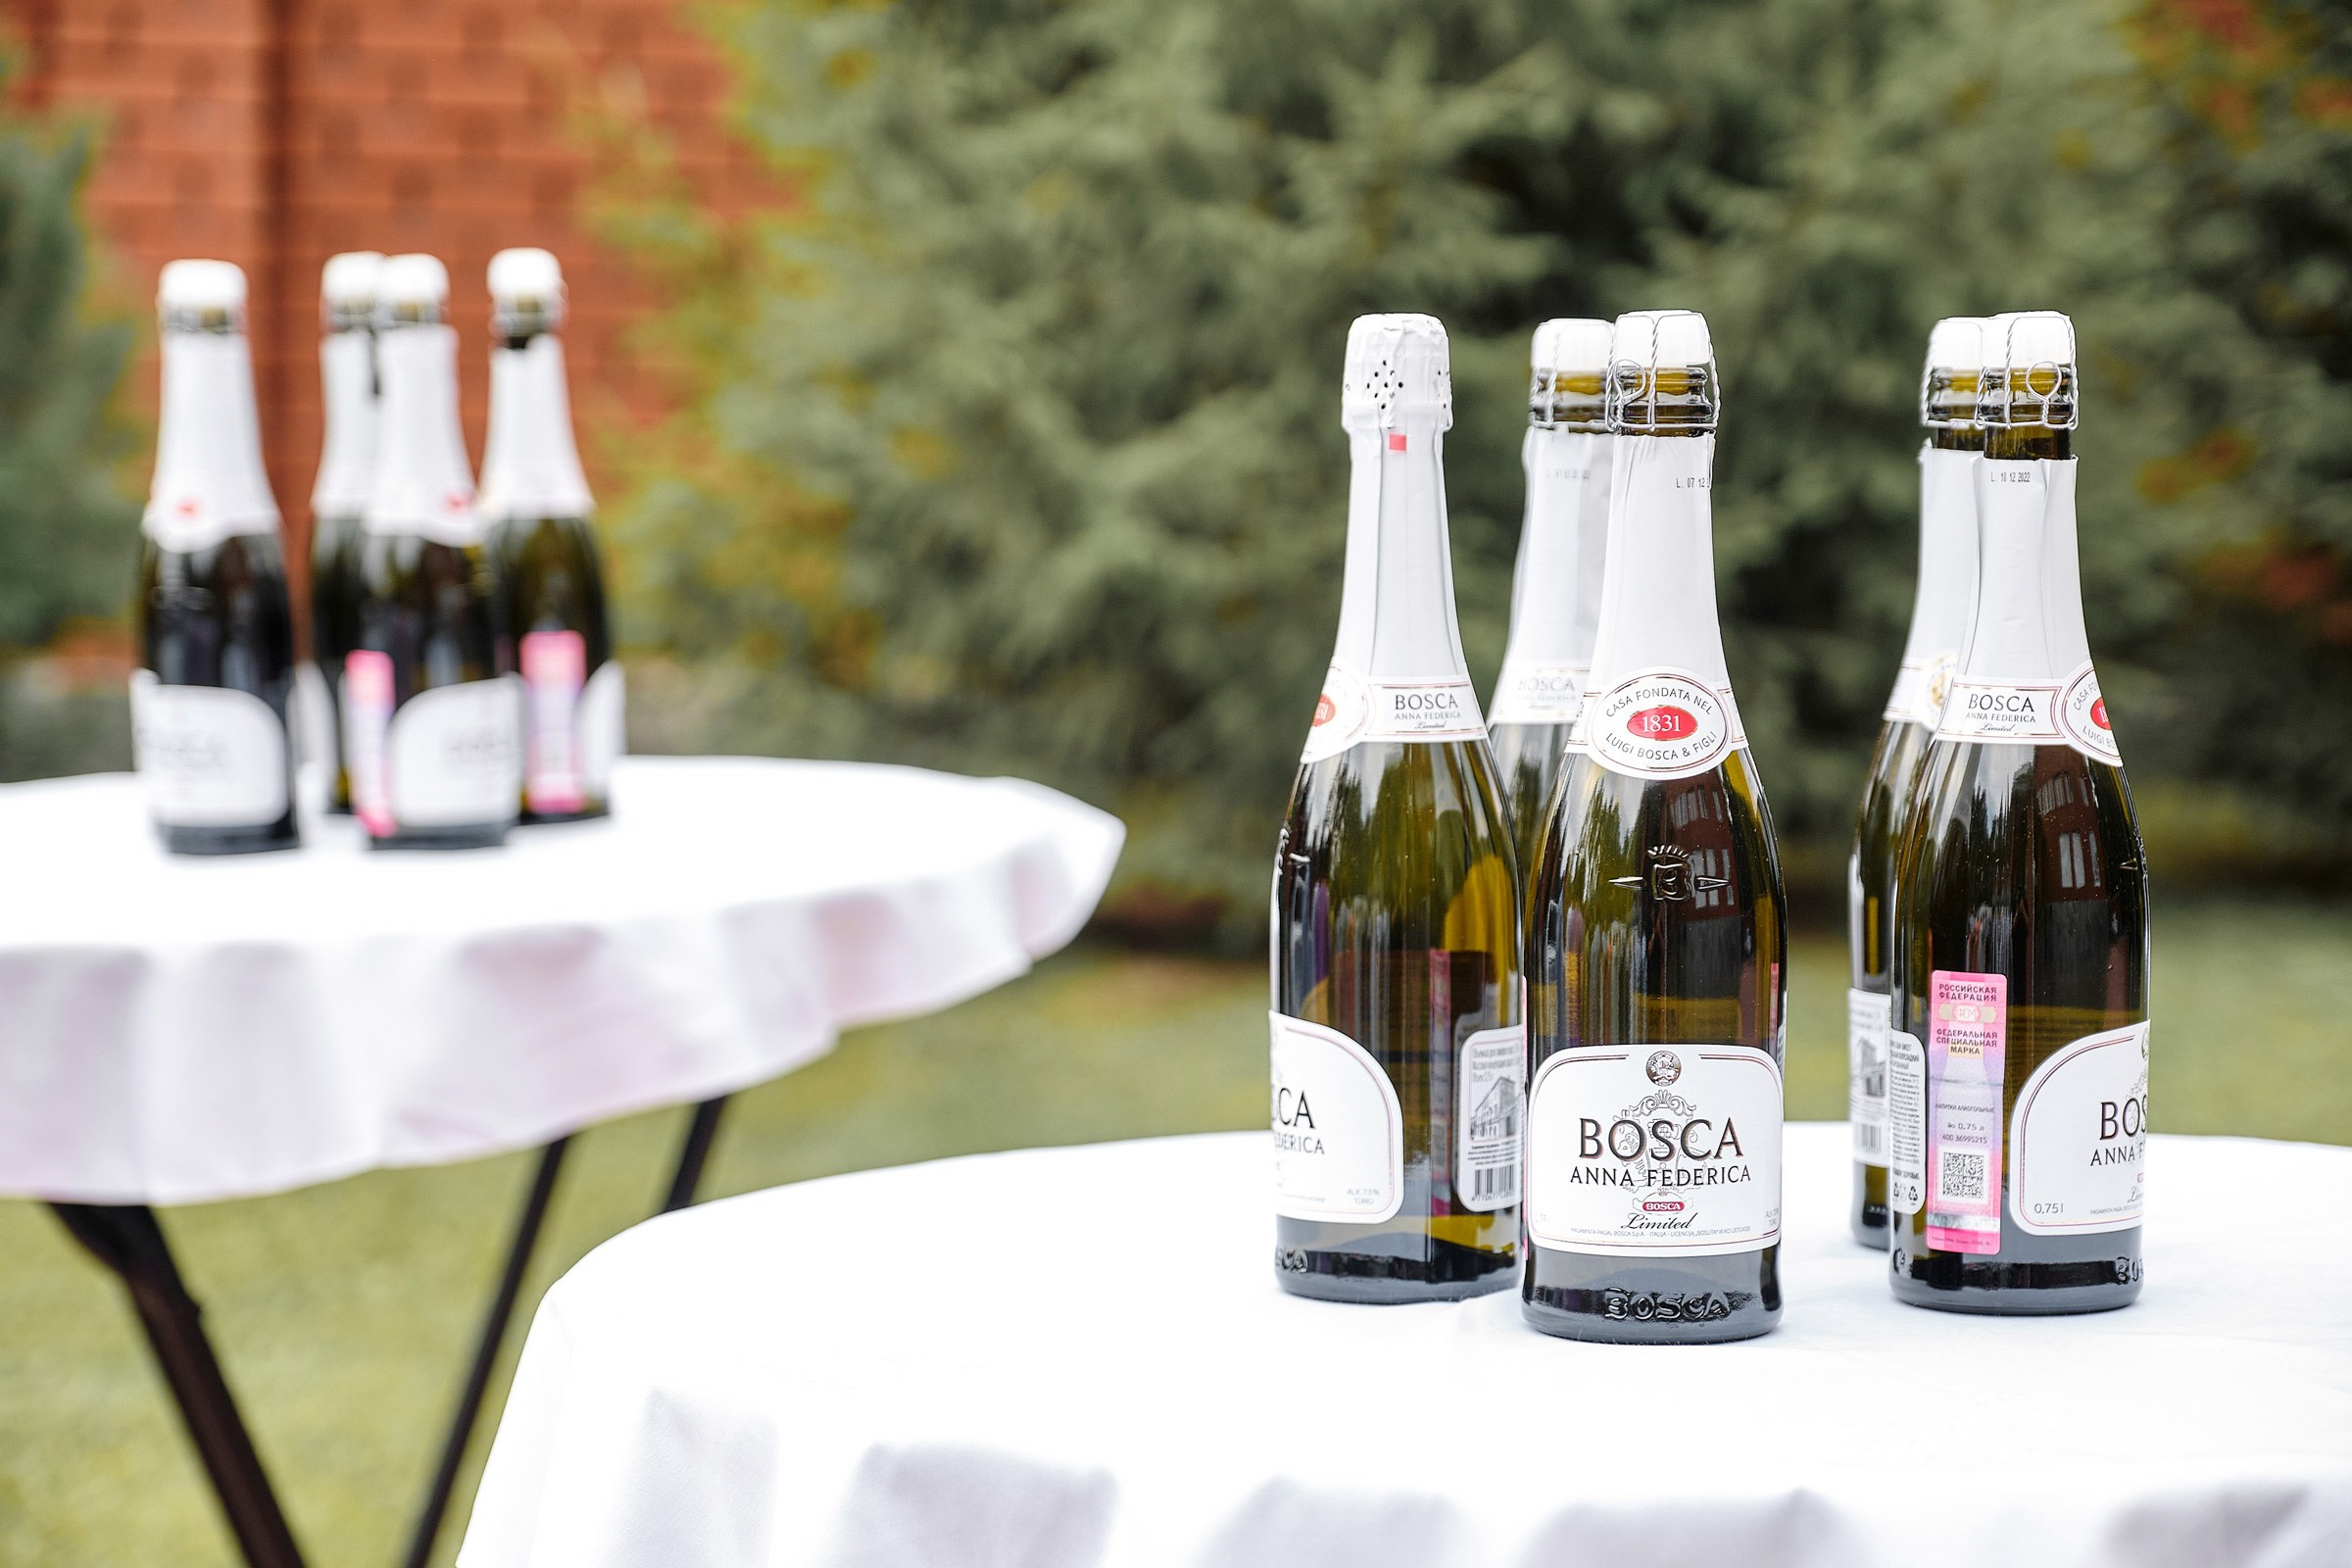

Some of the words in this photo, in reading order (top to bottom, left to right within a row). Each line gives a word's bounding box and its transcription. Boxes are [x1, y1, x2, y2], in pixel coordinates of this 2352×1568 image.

[1687, 477, 1695, 488] 07
[1395, 693, 1459, 710] BOSCA
[1605, 696, 1633, 717] CASA
[1636, 687, 1691, 701] FONDATA
[1694, 695, 1713, 714] NEL
[1968, 693, 2035, 712] BOSCA
[2074, 688, 2090, 710] CASA
[1395, 711, 1422, 720] ANNA
[1424, 710, 1462, 720] FEDERICA
[1642, 714, 1681, 732] 1831
[1965, 711, 1988, 720] ANNA
[1990, 713, 2036, 723] FEDERICA
[2082, 725, 2105, 746] LUIGI
[1605, 732, 1634, 755] LUIGI
[1638, 747, 1679, 760] BOSCA
[1682, 747, 1691, 758] &
[1693, 731, 1717, 754] FIGLI
[1938, 983, 1997, 994] РОССИЙСКАЯ
[1938, 992, 1997, 1002] ФЕДЕРАЦИЯ
[1936, 1028, 1997, 1039] ФЕДЕРАЛЬНАЯ
[1936, 1036, 1997, 1048] СПЕЦИАЛЬНАЯ
[1950, 1046, 1981, 1054] МАРКА
[1579, 1117, 1744, 1161] BOSCA
[2090, 1145, 2135, 1166] ANNA
[1570, 1166, 1635, 1186] ANNA
[1647, 1164, 1751, 1187] FEDERICA
[1645, 1201, 1682, 1211] BOSCA
[1620, 1212, 1698, 1230] Limited
[1604, 1286, 1732, 1321] BOSCA
